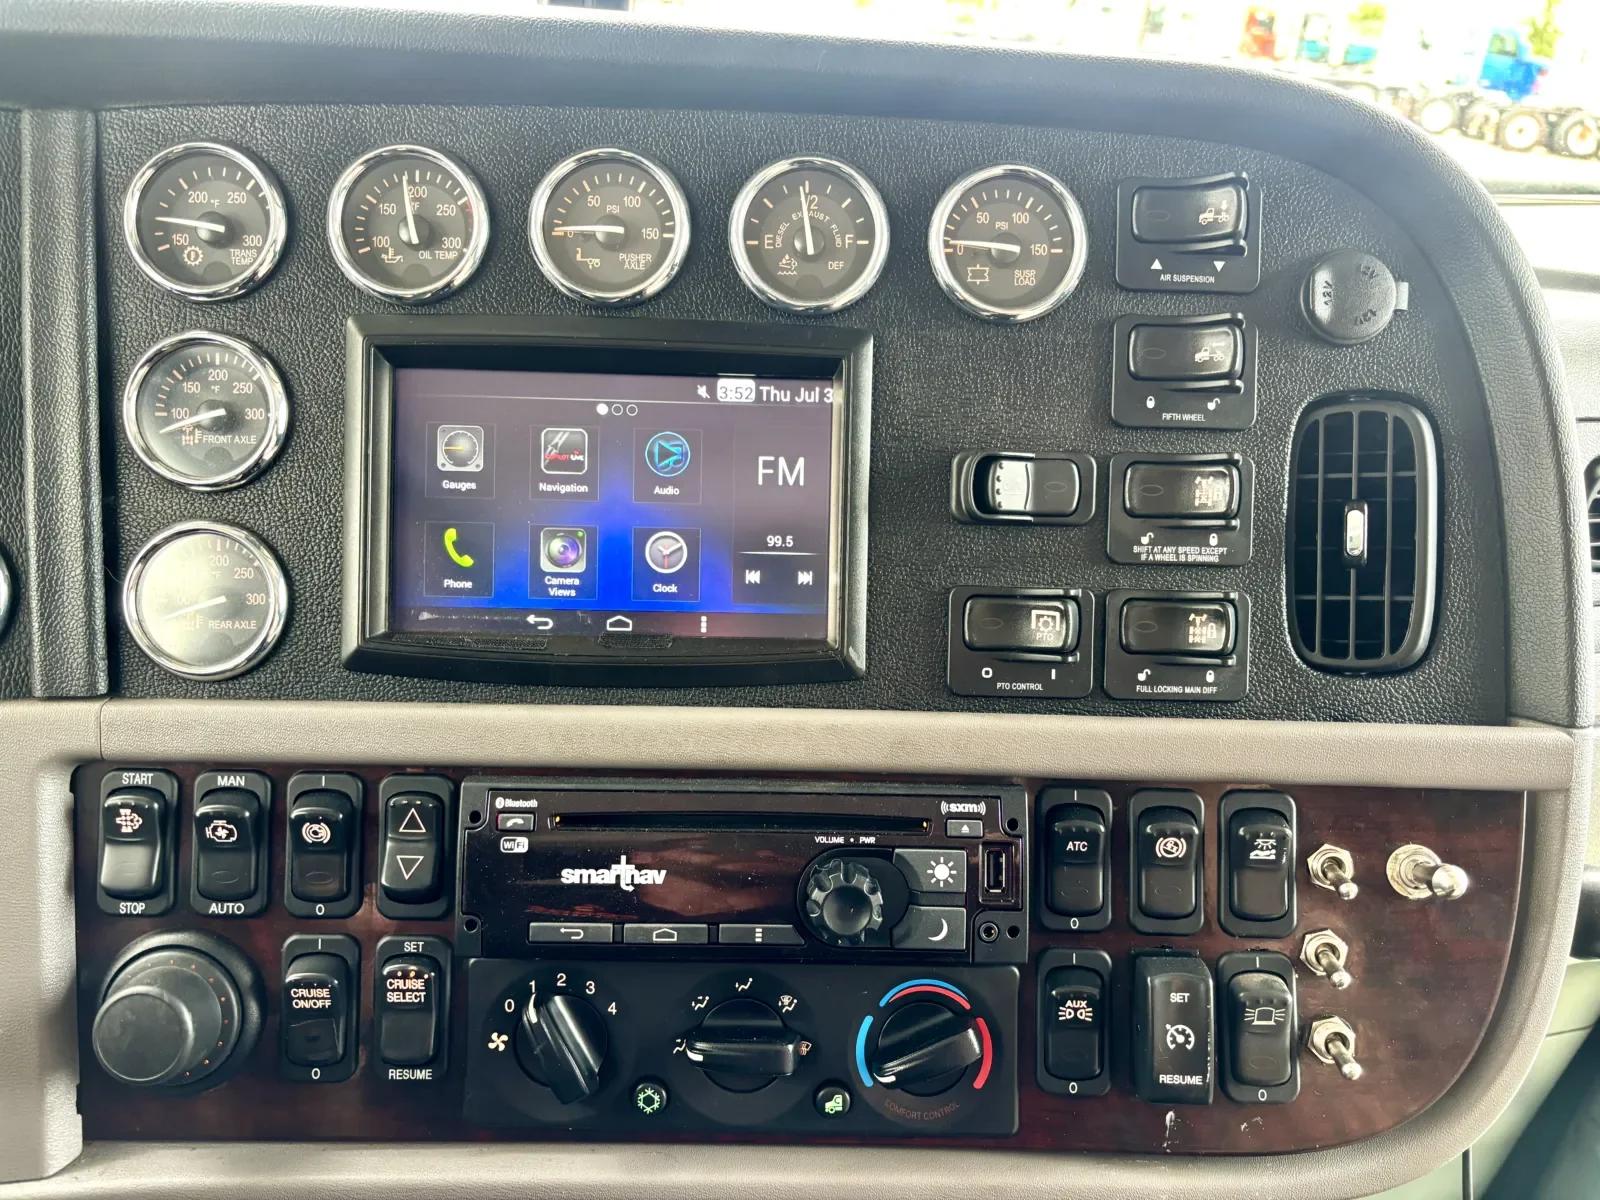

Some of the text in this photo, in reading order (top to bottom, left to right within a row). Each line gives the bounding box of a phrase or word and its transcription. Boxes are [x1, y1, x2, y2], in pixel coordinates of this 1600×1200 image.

[188, 191, 208, 204] 200
[408, 186, 428, 198] 200
[227, 192, 246, 204] 250
[587, 196, 600, 208] 50
[624, 196, 640, 208] 100
[379, 204, 396, 215] 150
[436, 204, 456, 216] 250
[606, 205, 620, 213] PSI
[976, 212, 990, 224] 50
[1012, 212, 1030, 224] 100
[776, 210, 842, 248] DIESEL EXAUST FLUID
[996, 222, 1008, 230] PSI
[641, 228, 659, 240] 150
[172, 234, 189, 246] 150
[242, 235, 262, 247] 300
[372, 236, 390, 248] 100
[442, 237, 461, 249] 300
[764, 234, 774, 248] E
[846, 234, 854, 248] F
[230, 249, 258, 258] TRANS
[418, 250, 458, 260] OIL TEMP
[957, 244, 964, 256] 0
[1030, 244, 1048, 256] 150
[232, 256, 254, 265] TEMP
[620, 253, 652, 262] PUSHER
[624, 262, 646, 270] AXLE
[828, 261, 844, 270] DEF
[1014, 278, 1036, 286] LOAD
[1160, 274, 1214, 284] AIR SUSPENSION
[208, 369, 228, 380] 200
[182, 382, 200, 393] 150
[232, 382, 252, 394] 250
[719, 386, 753, 400] 3:52
[760, 385, 790, 402] Thu
[795, 386, 820, 402] Jul
[171, 408, 189, 419] 100
[244, 408, 264, 420] 300
[1162, 412, 1206, 422] FIFTH WHEEL
[203, 436, 256, 444] FRONT AXLE
[758, 456, 804, 486] FM
[442, 480, 476, 490] Gauges
[539, 482, 588, 494] Navigation
[654, 484, 680, 496] Audio
[766, 536, 794, 548] 99.5
[1153, 546, 1162, 554] AT
[1163, 546, 1176, 554] ANY
[1178, 546, 1200, 554] SPEED
[1202, 547, 1228, 555] EXCEPT
[209, 555, 229, 566] 200
[1154, 554, 1178, 562] WHEEL
[1180, 554, 1186, 562] IS
[1188, 554, 1220, 562] SPINNING
[234, 568, 254, 579] 250
[444, 578, 473, 590] Phone
[544, 576, 580, 586] Camera
[548, 586, 576, 597] Views
[652, 582, 678, 594] Clock
[246, 594, 266, 605] 300
[208, 620, 256, 630] REAR AXLE
[1036, 632, 1054, 640] PTO
[996, 682, 1044, 690] PTO CONTROL
[1154, 686, 1182, 694] LOCKING
[1185, 686, 1200, 694] MAIN
[1202, 686, 1218, 694] DIFF
[122, 774, 154, 784] START
[218, 776, 245, 786] MAN
[505, 798, 538, 808] Bluetooth
[815, 836, 876, 844] VOLUME PWR
[1066, 841, 1088, 852] ATC
[560, 855, 667, 892] smartnav
[120, 902, 145, 914] STOP
[209, 902, 244, 914] AUTO
[404, 942, 424, 952] SET
[387, 979, 425, 990] CRUISE
[556, 973, 566, 986] 2
[529, 980, 536, 993] 1
[586, 981, 596, 994] 3
[291, 988, 330, 998] CRUISE
[387, 992, 426, 1002] SELECT
[1170, 992, 1190, 1002] SET
[292, 1000, 332, 1008] ON/OFF
[504, 999, 514, 1012] 0
[608, 1002, 617, 1015] 4
[1066, 1000, 1087, 1008] AUX
[388, 1069, 432, 1080] RESUME
[1160, 1074, 1202, 1085] RESUME
